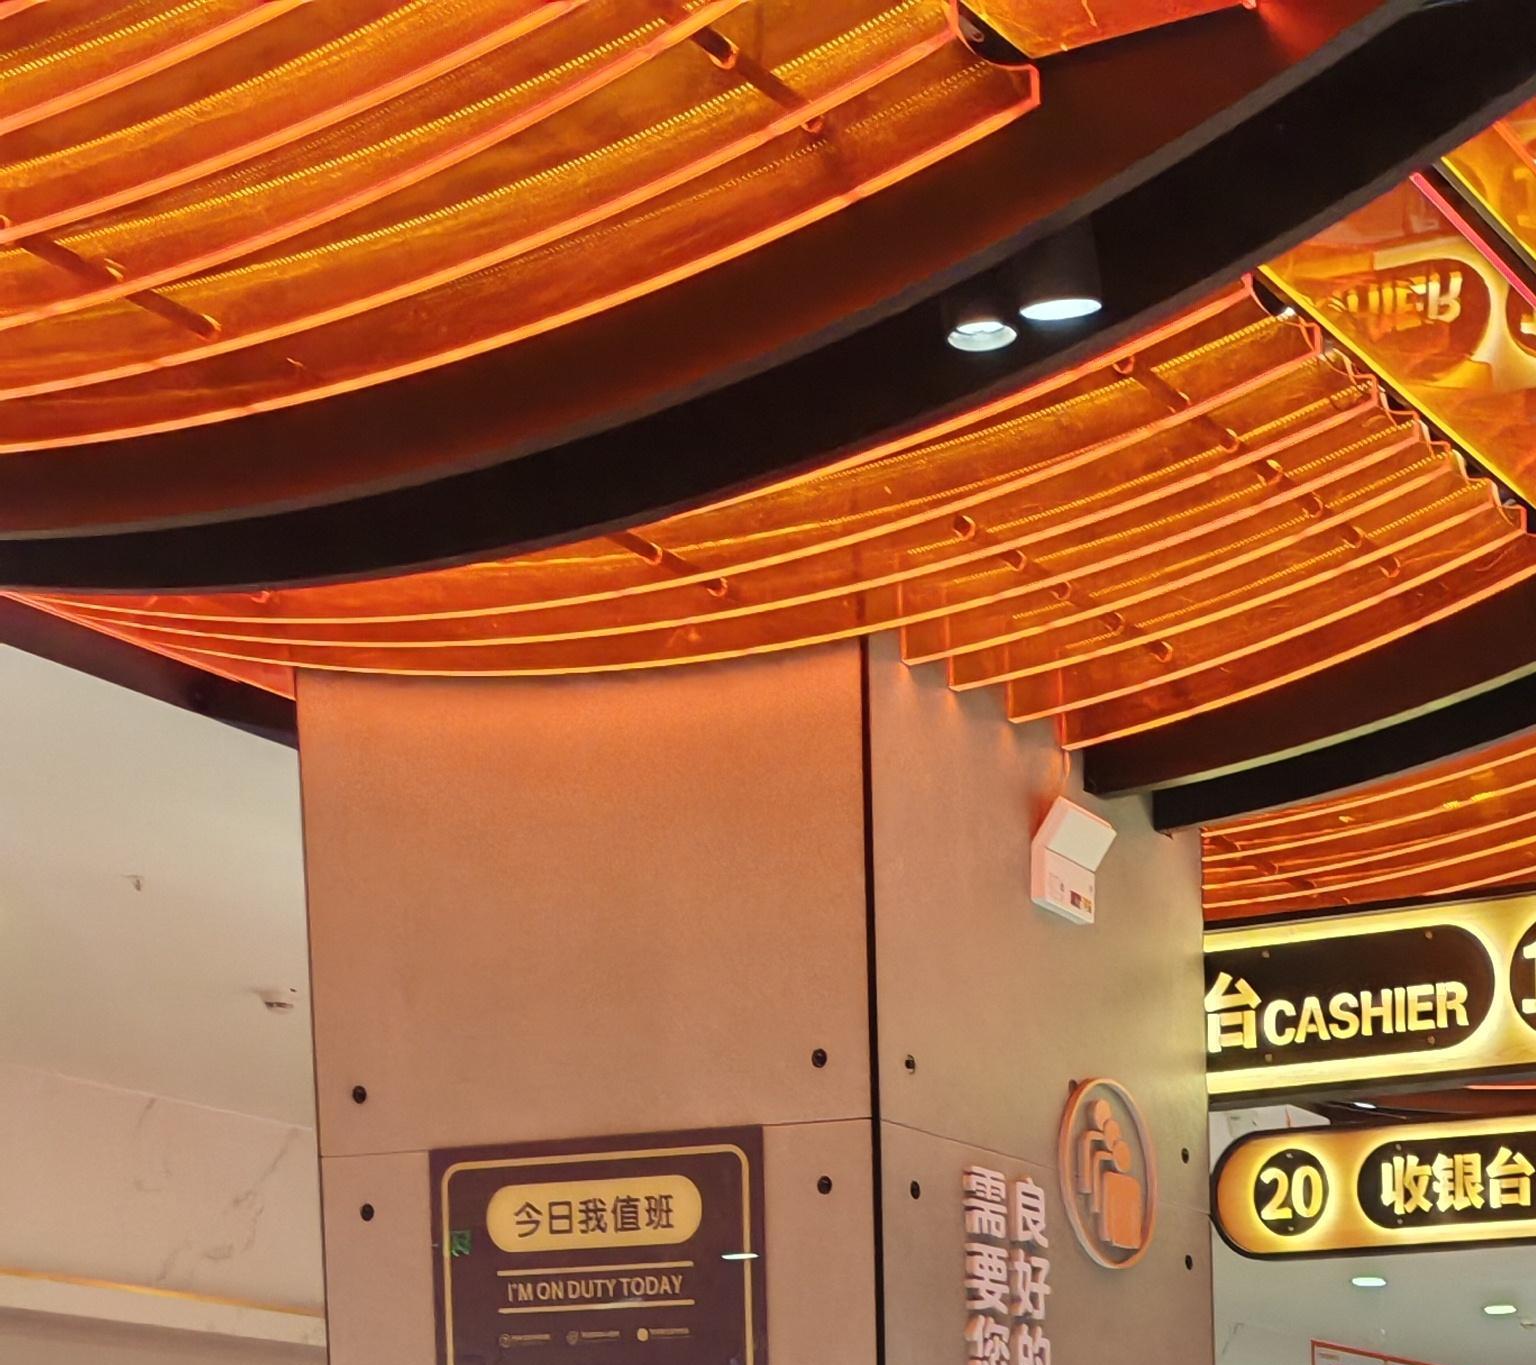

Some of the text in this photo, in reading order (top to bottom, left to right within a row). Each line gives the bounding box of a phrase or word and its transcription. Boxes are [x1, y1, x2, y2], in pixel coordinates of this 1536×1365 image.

[1264, 980, 1470, 1046] CASHIER
[1258, 1163, 1324, 1223] 20
[1379, 1149, 1536, 1216] 收银台
[513, 1192, 676, 1239] 今日我值班
[536, 1279, 565, 1301] ON
[567, 1277, 617, 1300] DUTY
[619, 1274, 684, 1299] TODAY
